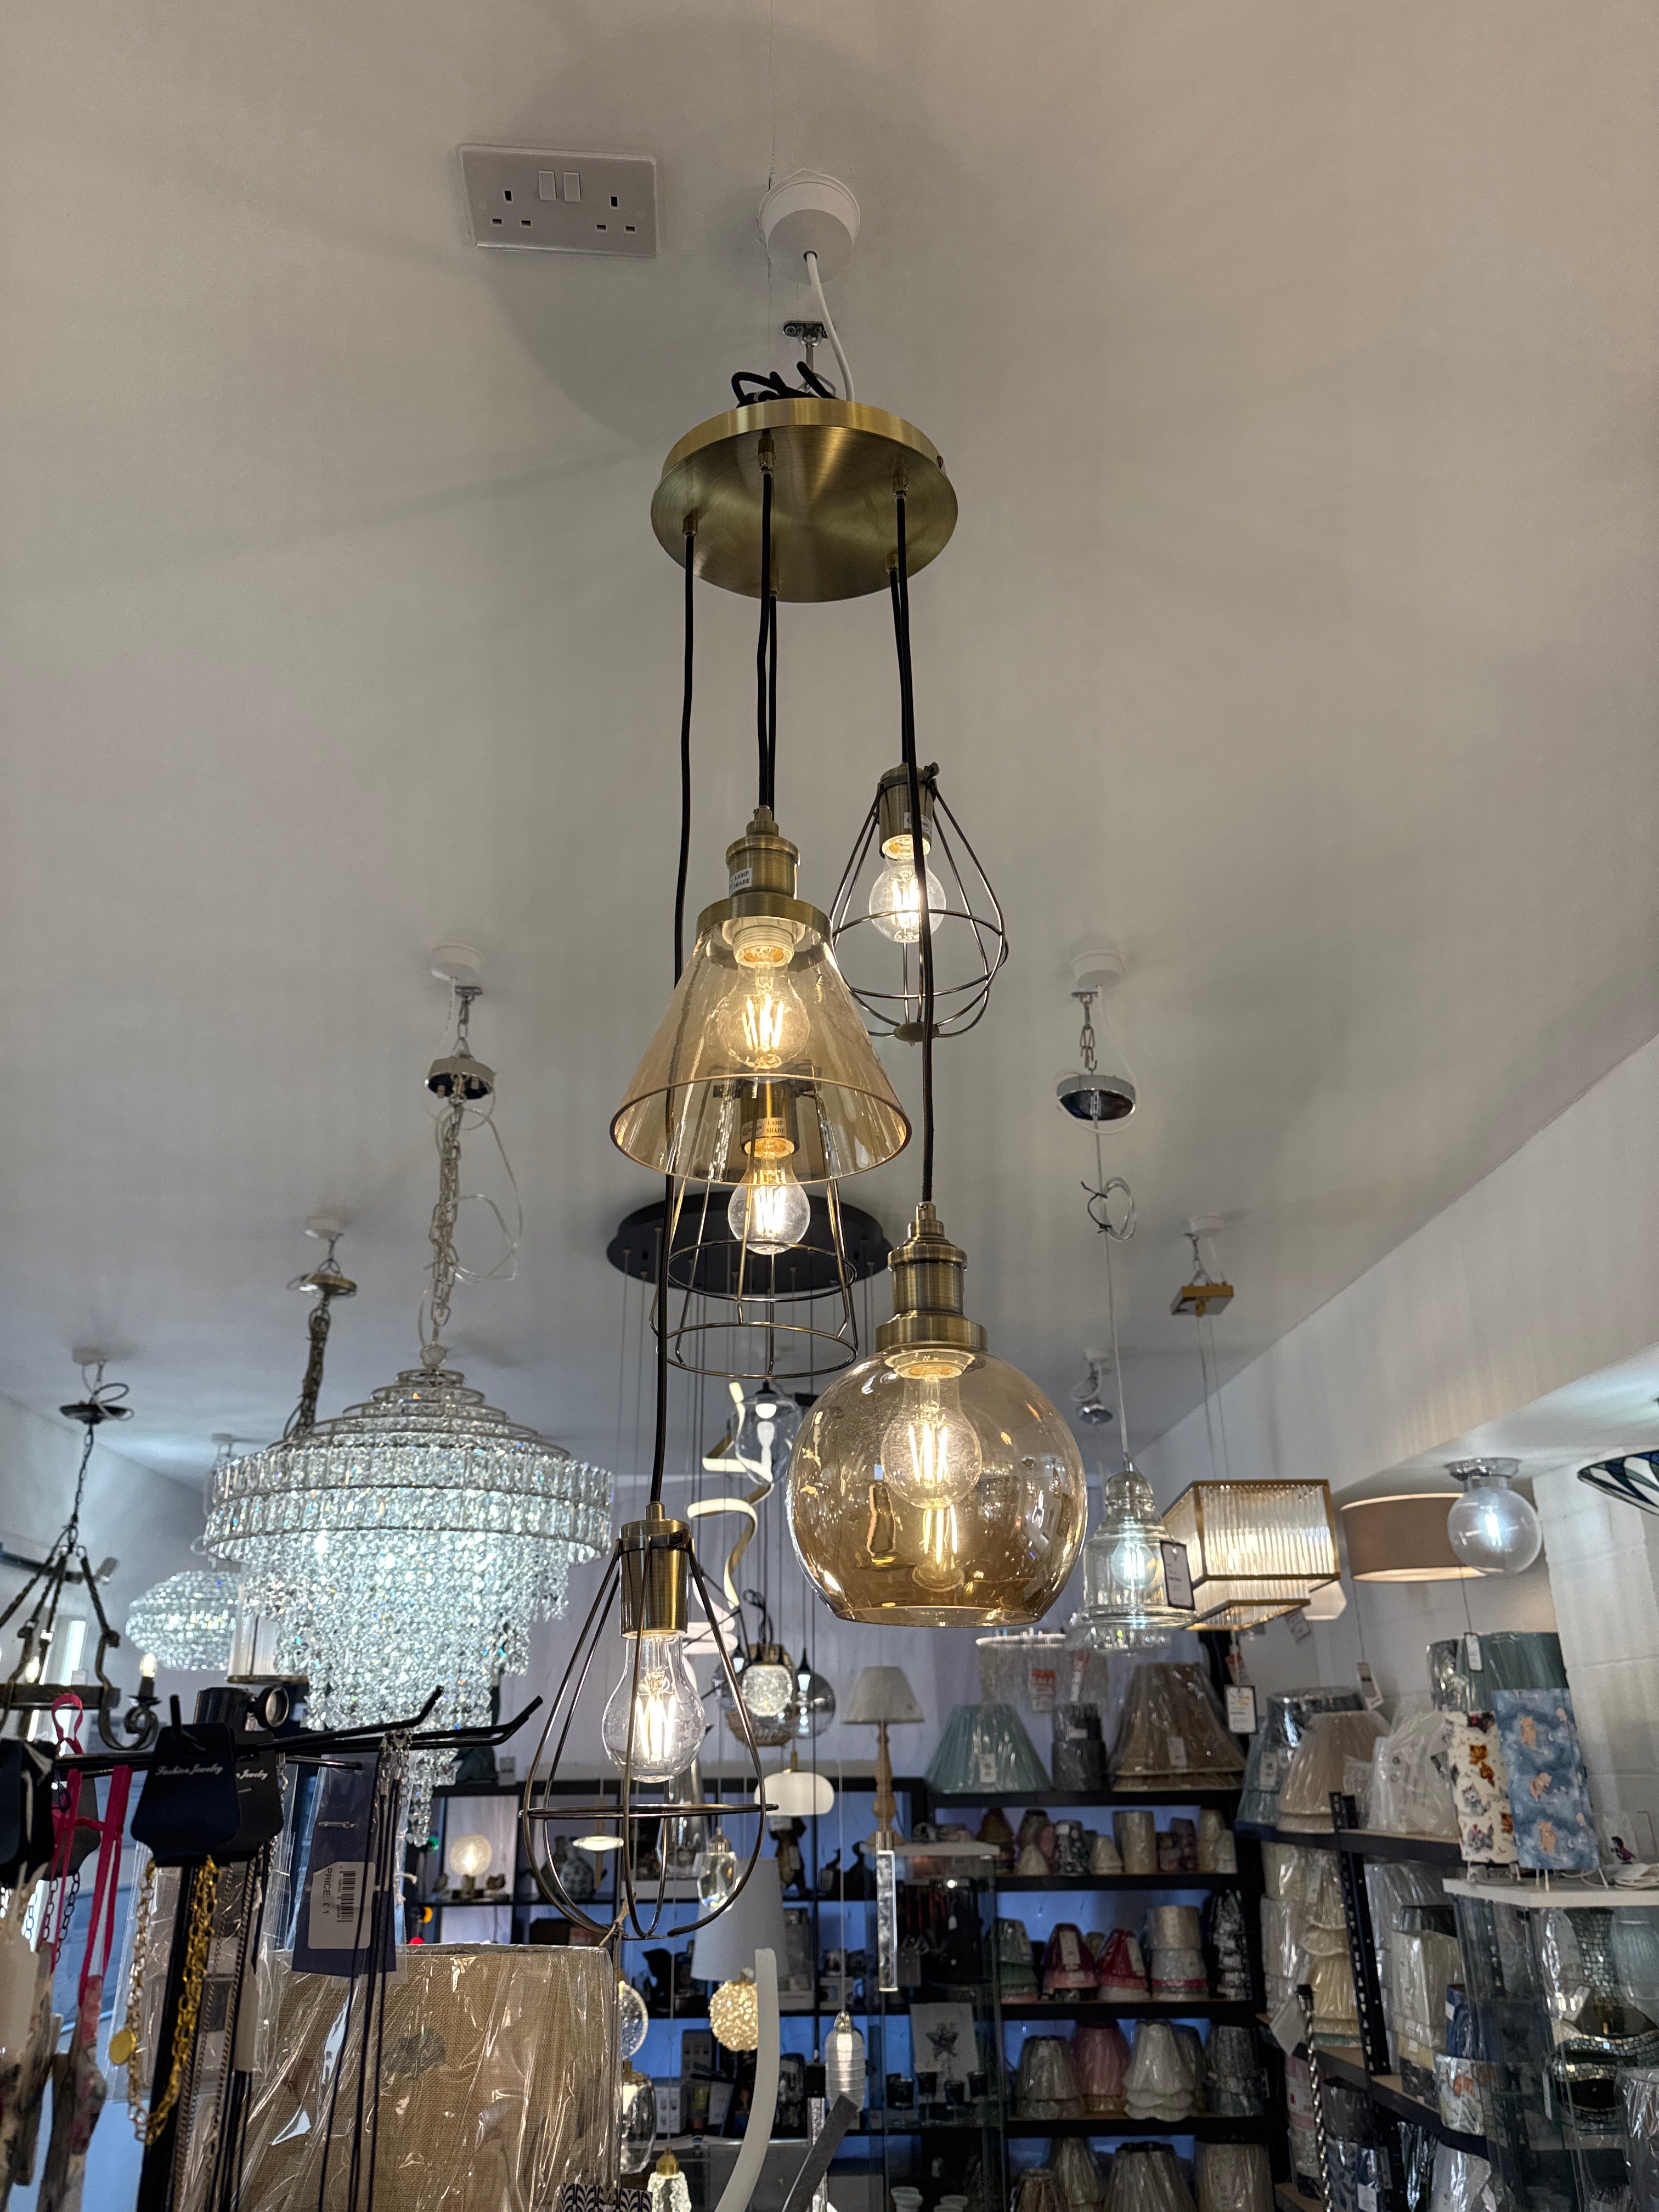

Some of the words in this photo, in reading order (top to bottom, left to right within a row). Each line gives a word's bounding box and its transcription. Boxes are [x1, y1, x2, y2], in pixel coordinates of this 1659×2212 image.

[735, 871, 749, 881] LAMP
[733, 878, 750, 889] SHADE
[155, 1765, 190, 1776] Fashion
[189, 1763, 224, 1776] Jewelry
[239, 1769, 268, 1780] Jewelry
[323, 1867, 332, 1898] PRICE:
